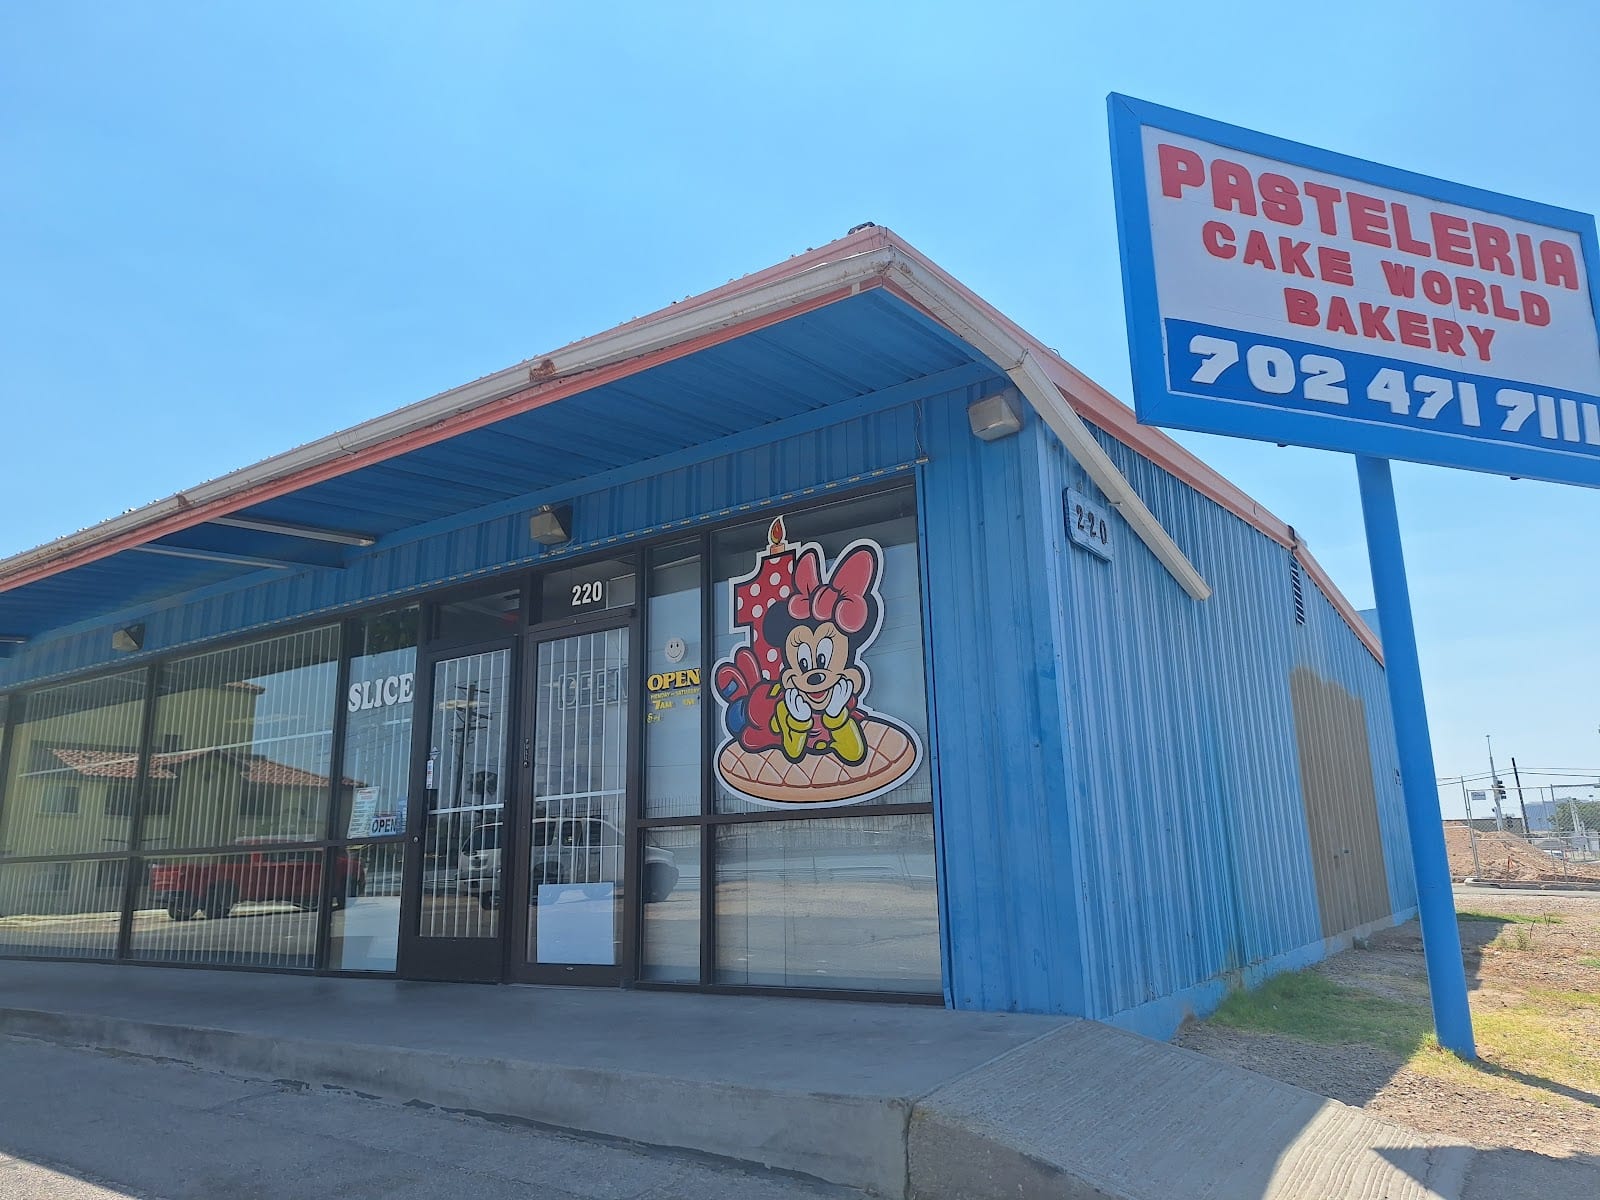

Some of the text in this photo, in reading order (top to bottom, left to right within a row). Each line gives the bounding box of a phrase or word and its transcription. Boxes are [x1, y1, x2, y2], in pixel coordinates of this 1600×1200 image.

[1157, 143, 1579, 290] PASTELERIA
[1202, 221, 1551, 328] CAKE WORLD
[1283, 287, 1497, 362] BAKERY
[1188, 334, 1600, 446] 702 471 7111
[1076, 504, 1108, 545] 220
[571, 581, 603, 606] 220
[348, 672, 414, 713] SLICE
[562, 669, 629, 706] OPEN
[647, 668, 701, 692] OPEN
[372, 818, 397, 834] OPEN
